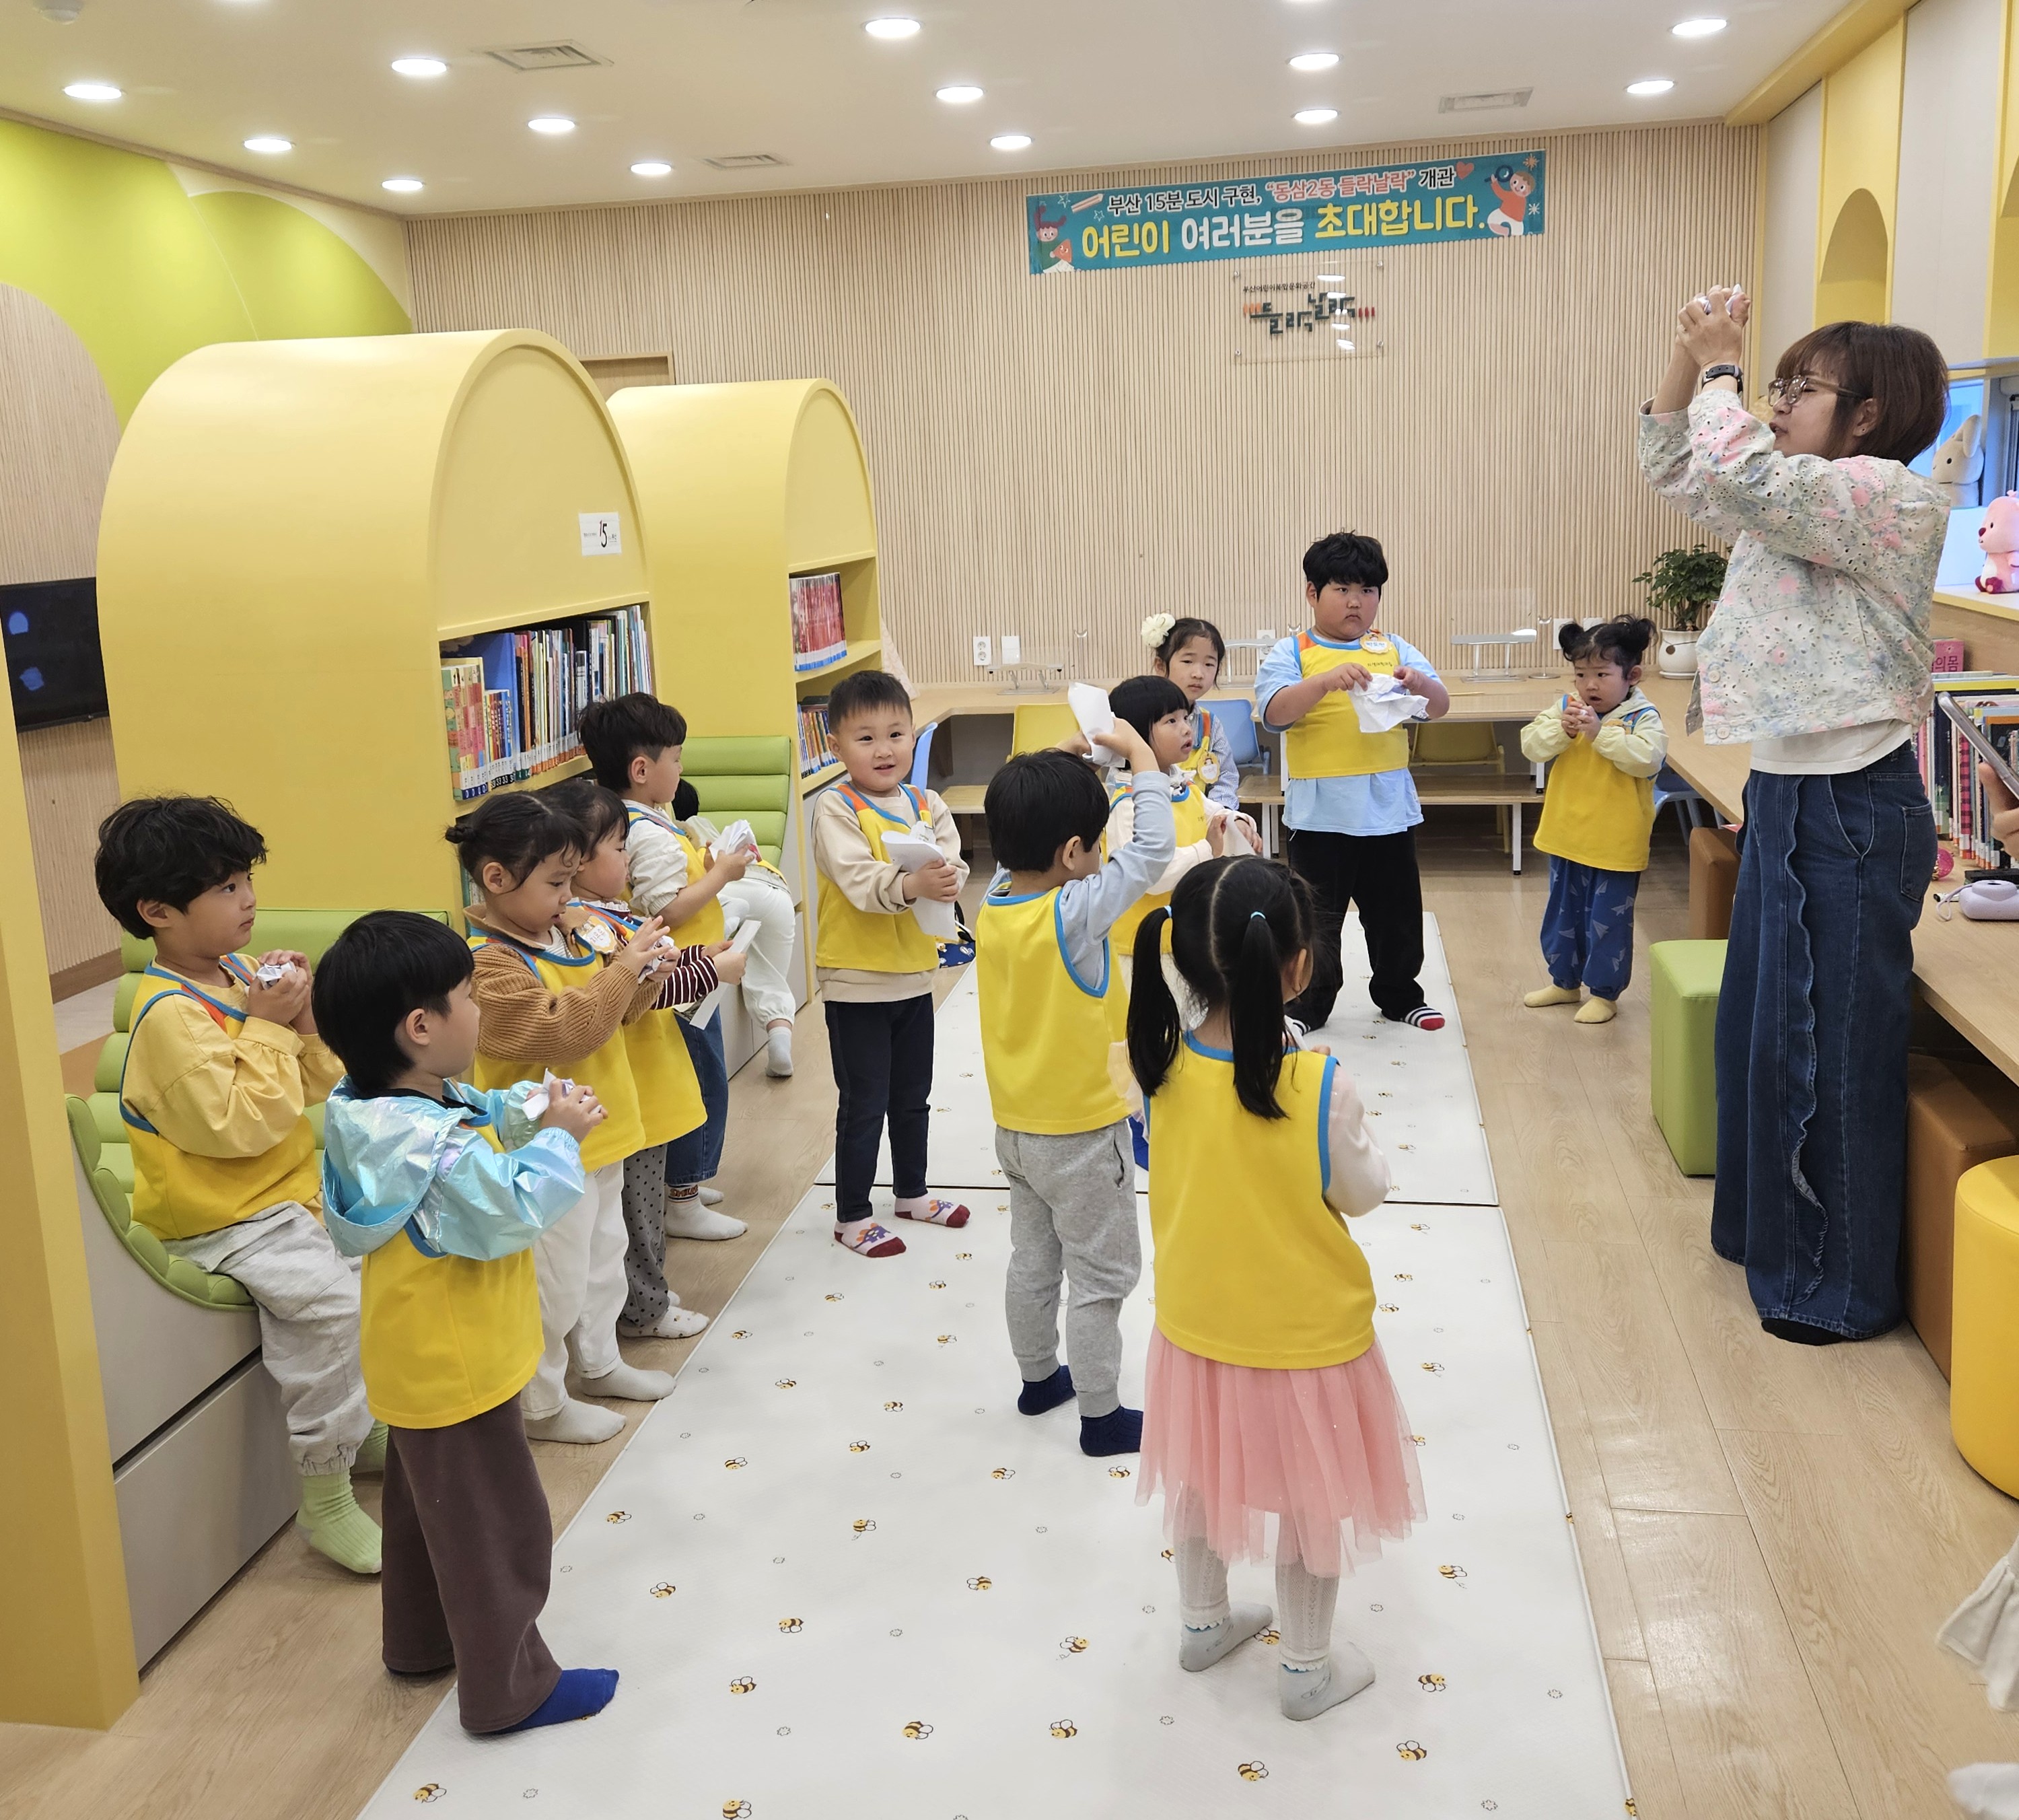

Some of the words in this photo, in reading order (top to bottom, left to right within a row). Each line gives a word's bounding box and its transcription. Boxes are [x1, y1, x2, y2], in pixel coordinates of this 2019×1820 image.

[1109, 195, 1141, 215] 부산
[1146, 193, 1182, 212] 15분
[1186, 188, 1218, 208] 도시
[1222, 185, 1261, 204] 구현,
[1420, 167, 1455, 189] 개관
[1082, 220, 1169, 258] 어린이
[1182, 208, 1304, 250] 여러분을
[1315, 194, 1485, 238] 초대합니다.
[599, 520, 608, 548] 15
